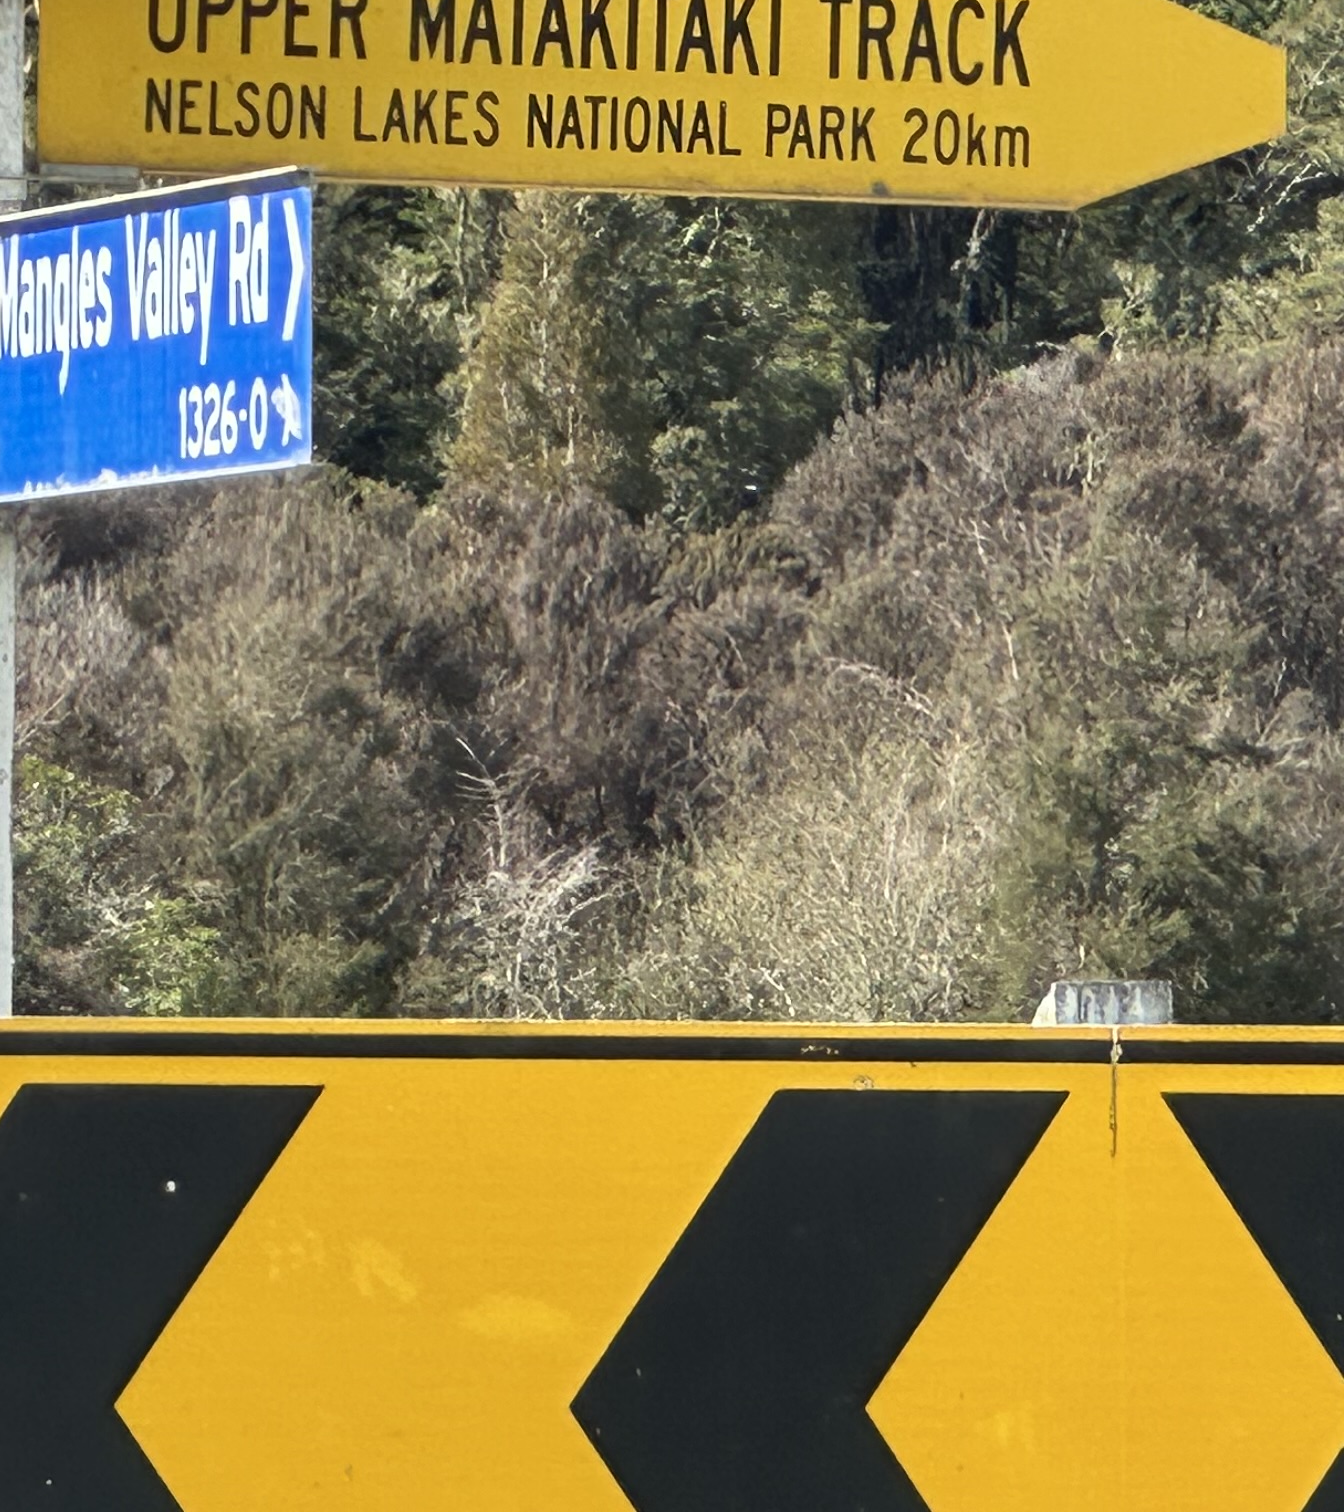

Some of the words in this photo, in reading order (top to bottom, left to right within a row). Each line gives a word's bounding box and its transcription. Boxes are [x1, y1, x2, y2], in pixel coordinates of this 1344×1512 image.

[144, 78, 327, 140] NELSON
[353, 85, 500, 148] LAKES
[526, 93, 742, 157] NATIONAL
[765, 103, 876, 162] PARK
[902, 107, 1030, 168] 20km
[124, 207, 216, 366] Valley
[228, 193, 269, 326] Rd
[179, 377, 268, 459] 1326-0
